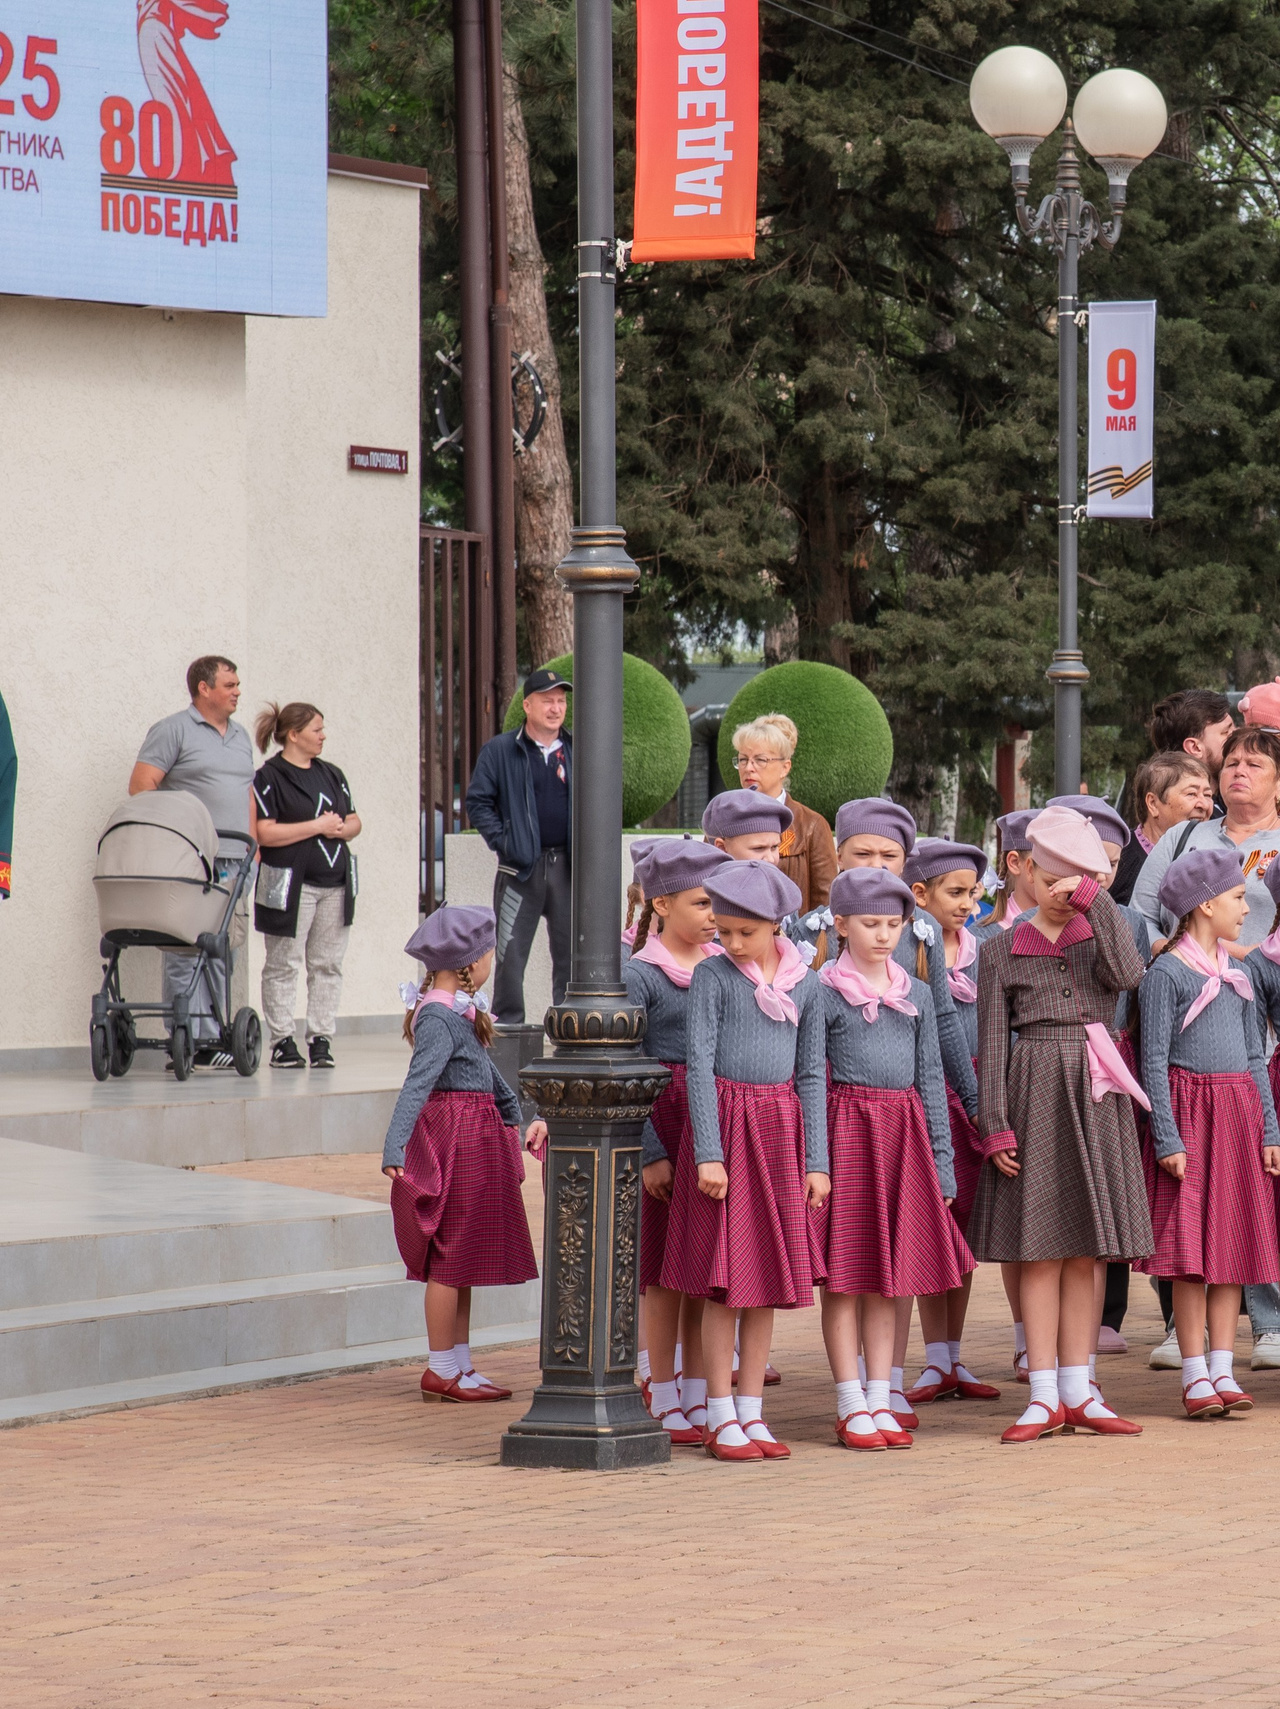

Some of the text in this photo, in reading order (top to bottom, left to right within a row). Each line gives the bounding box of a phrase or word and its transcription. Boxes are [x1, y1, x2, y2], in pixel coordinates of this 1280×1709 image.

[100, 95, 174, 180] 80
[101, 192, 238, 247] ПОБЕДА!
[1107, 348, 1137, 410] 9
[1106, 416, 1136, 431] МАЯ
